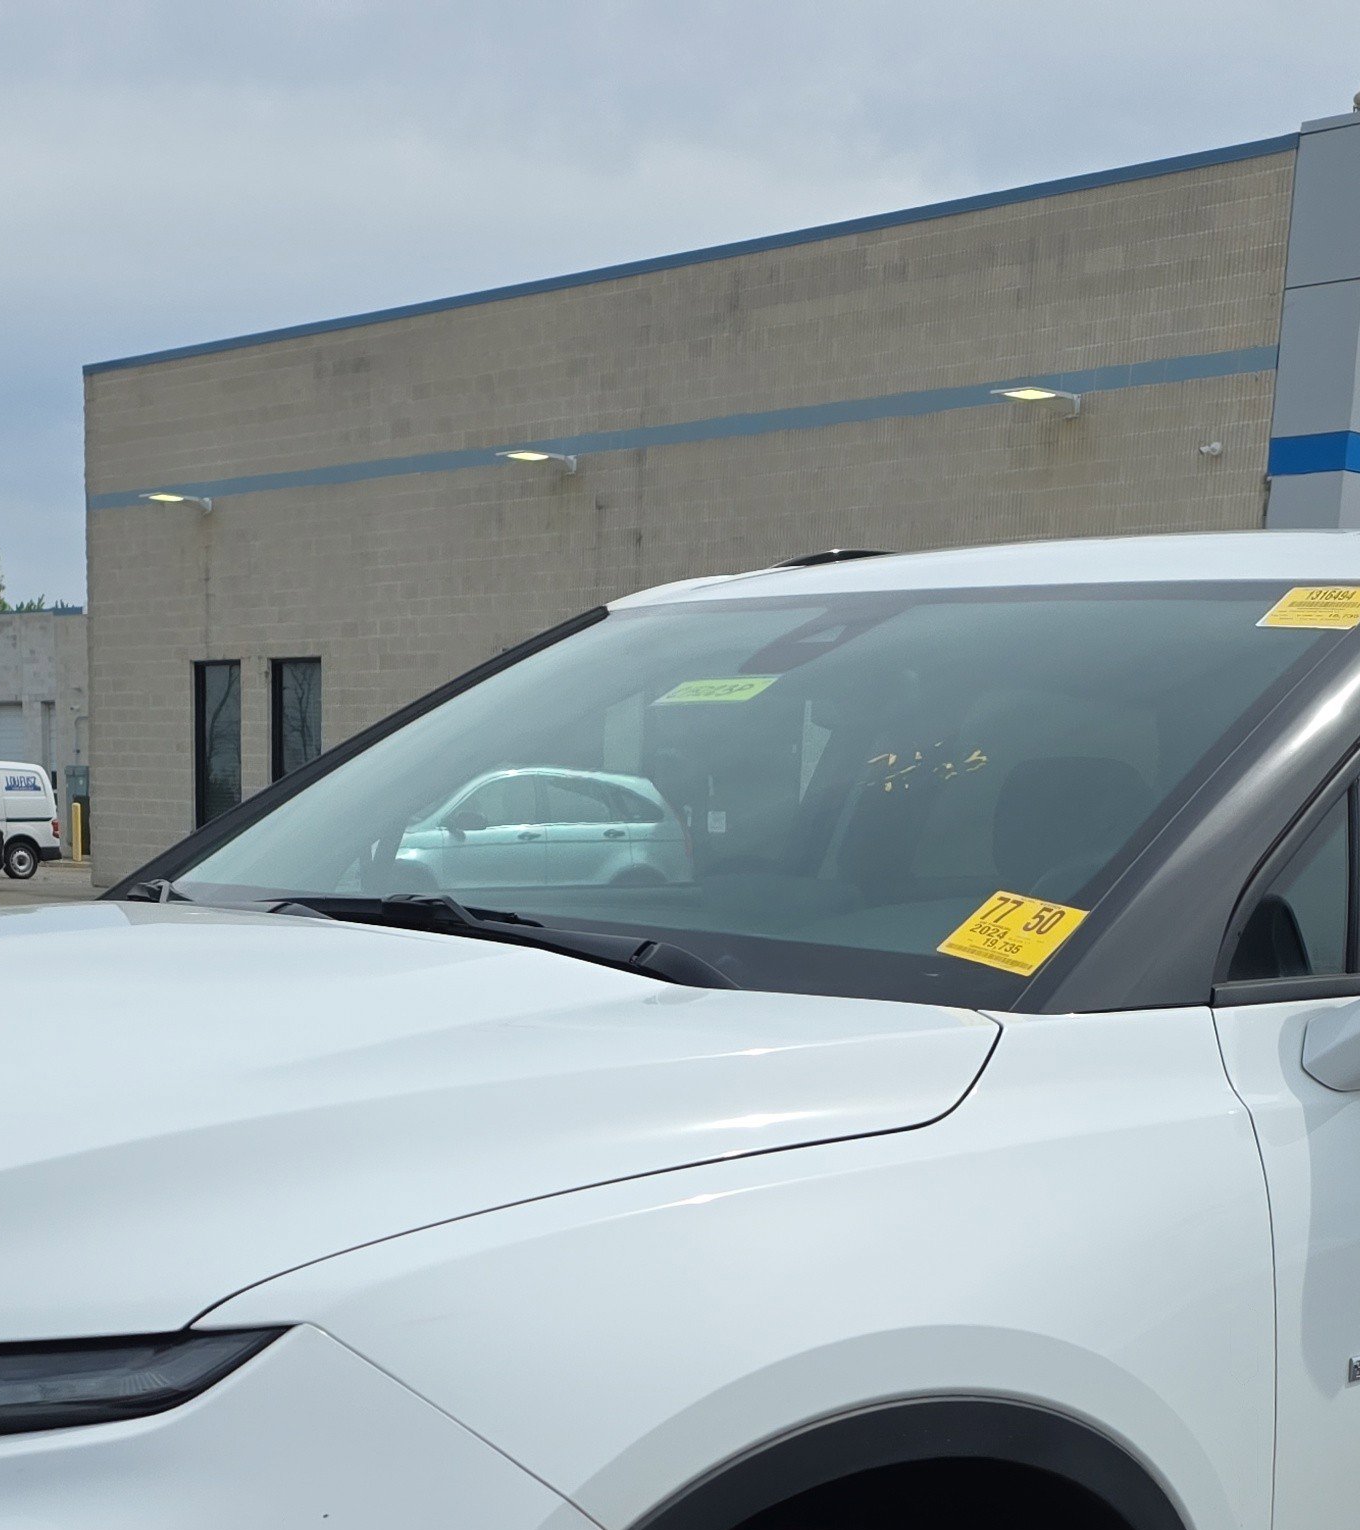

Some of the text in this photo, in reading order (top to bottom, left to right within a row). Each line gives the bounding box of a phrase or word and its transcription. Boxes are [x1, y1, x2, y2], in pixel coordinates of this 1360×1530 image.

[980, 896, 1066, 935] 77 50
[970, 923, 1008, 940] 2024
[982, 937, 1023, 955] 19,735
